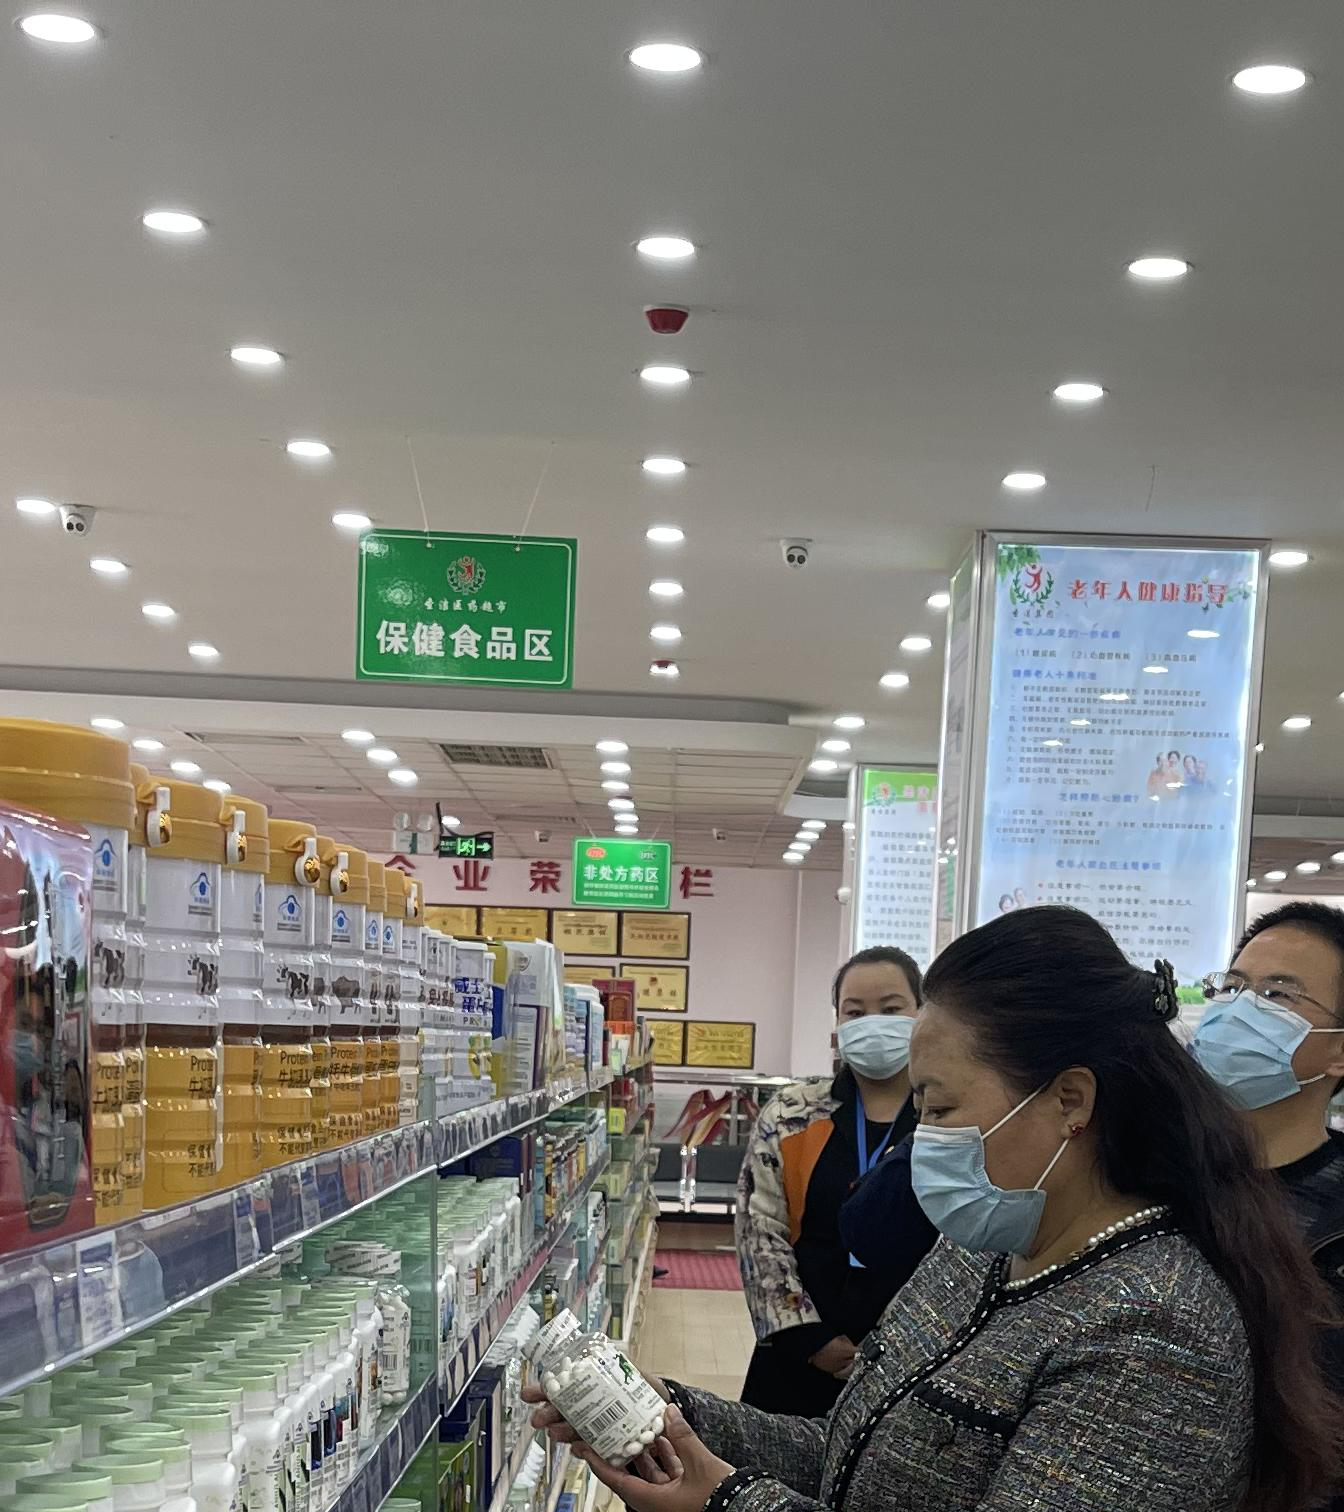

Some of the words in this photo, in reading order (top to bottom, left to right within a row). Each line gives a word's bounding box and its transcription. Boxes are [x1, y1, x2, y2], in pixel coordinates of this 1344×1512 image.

[1068, 579, 1228, 604] 老年人健康指导
[375, 619, 553, 662] 保健食品区
[583, 863, 660, 883] 非处方药区
